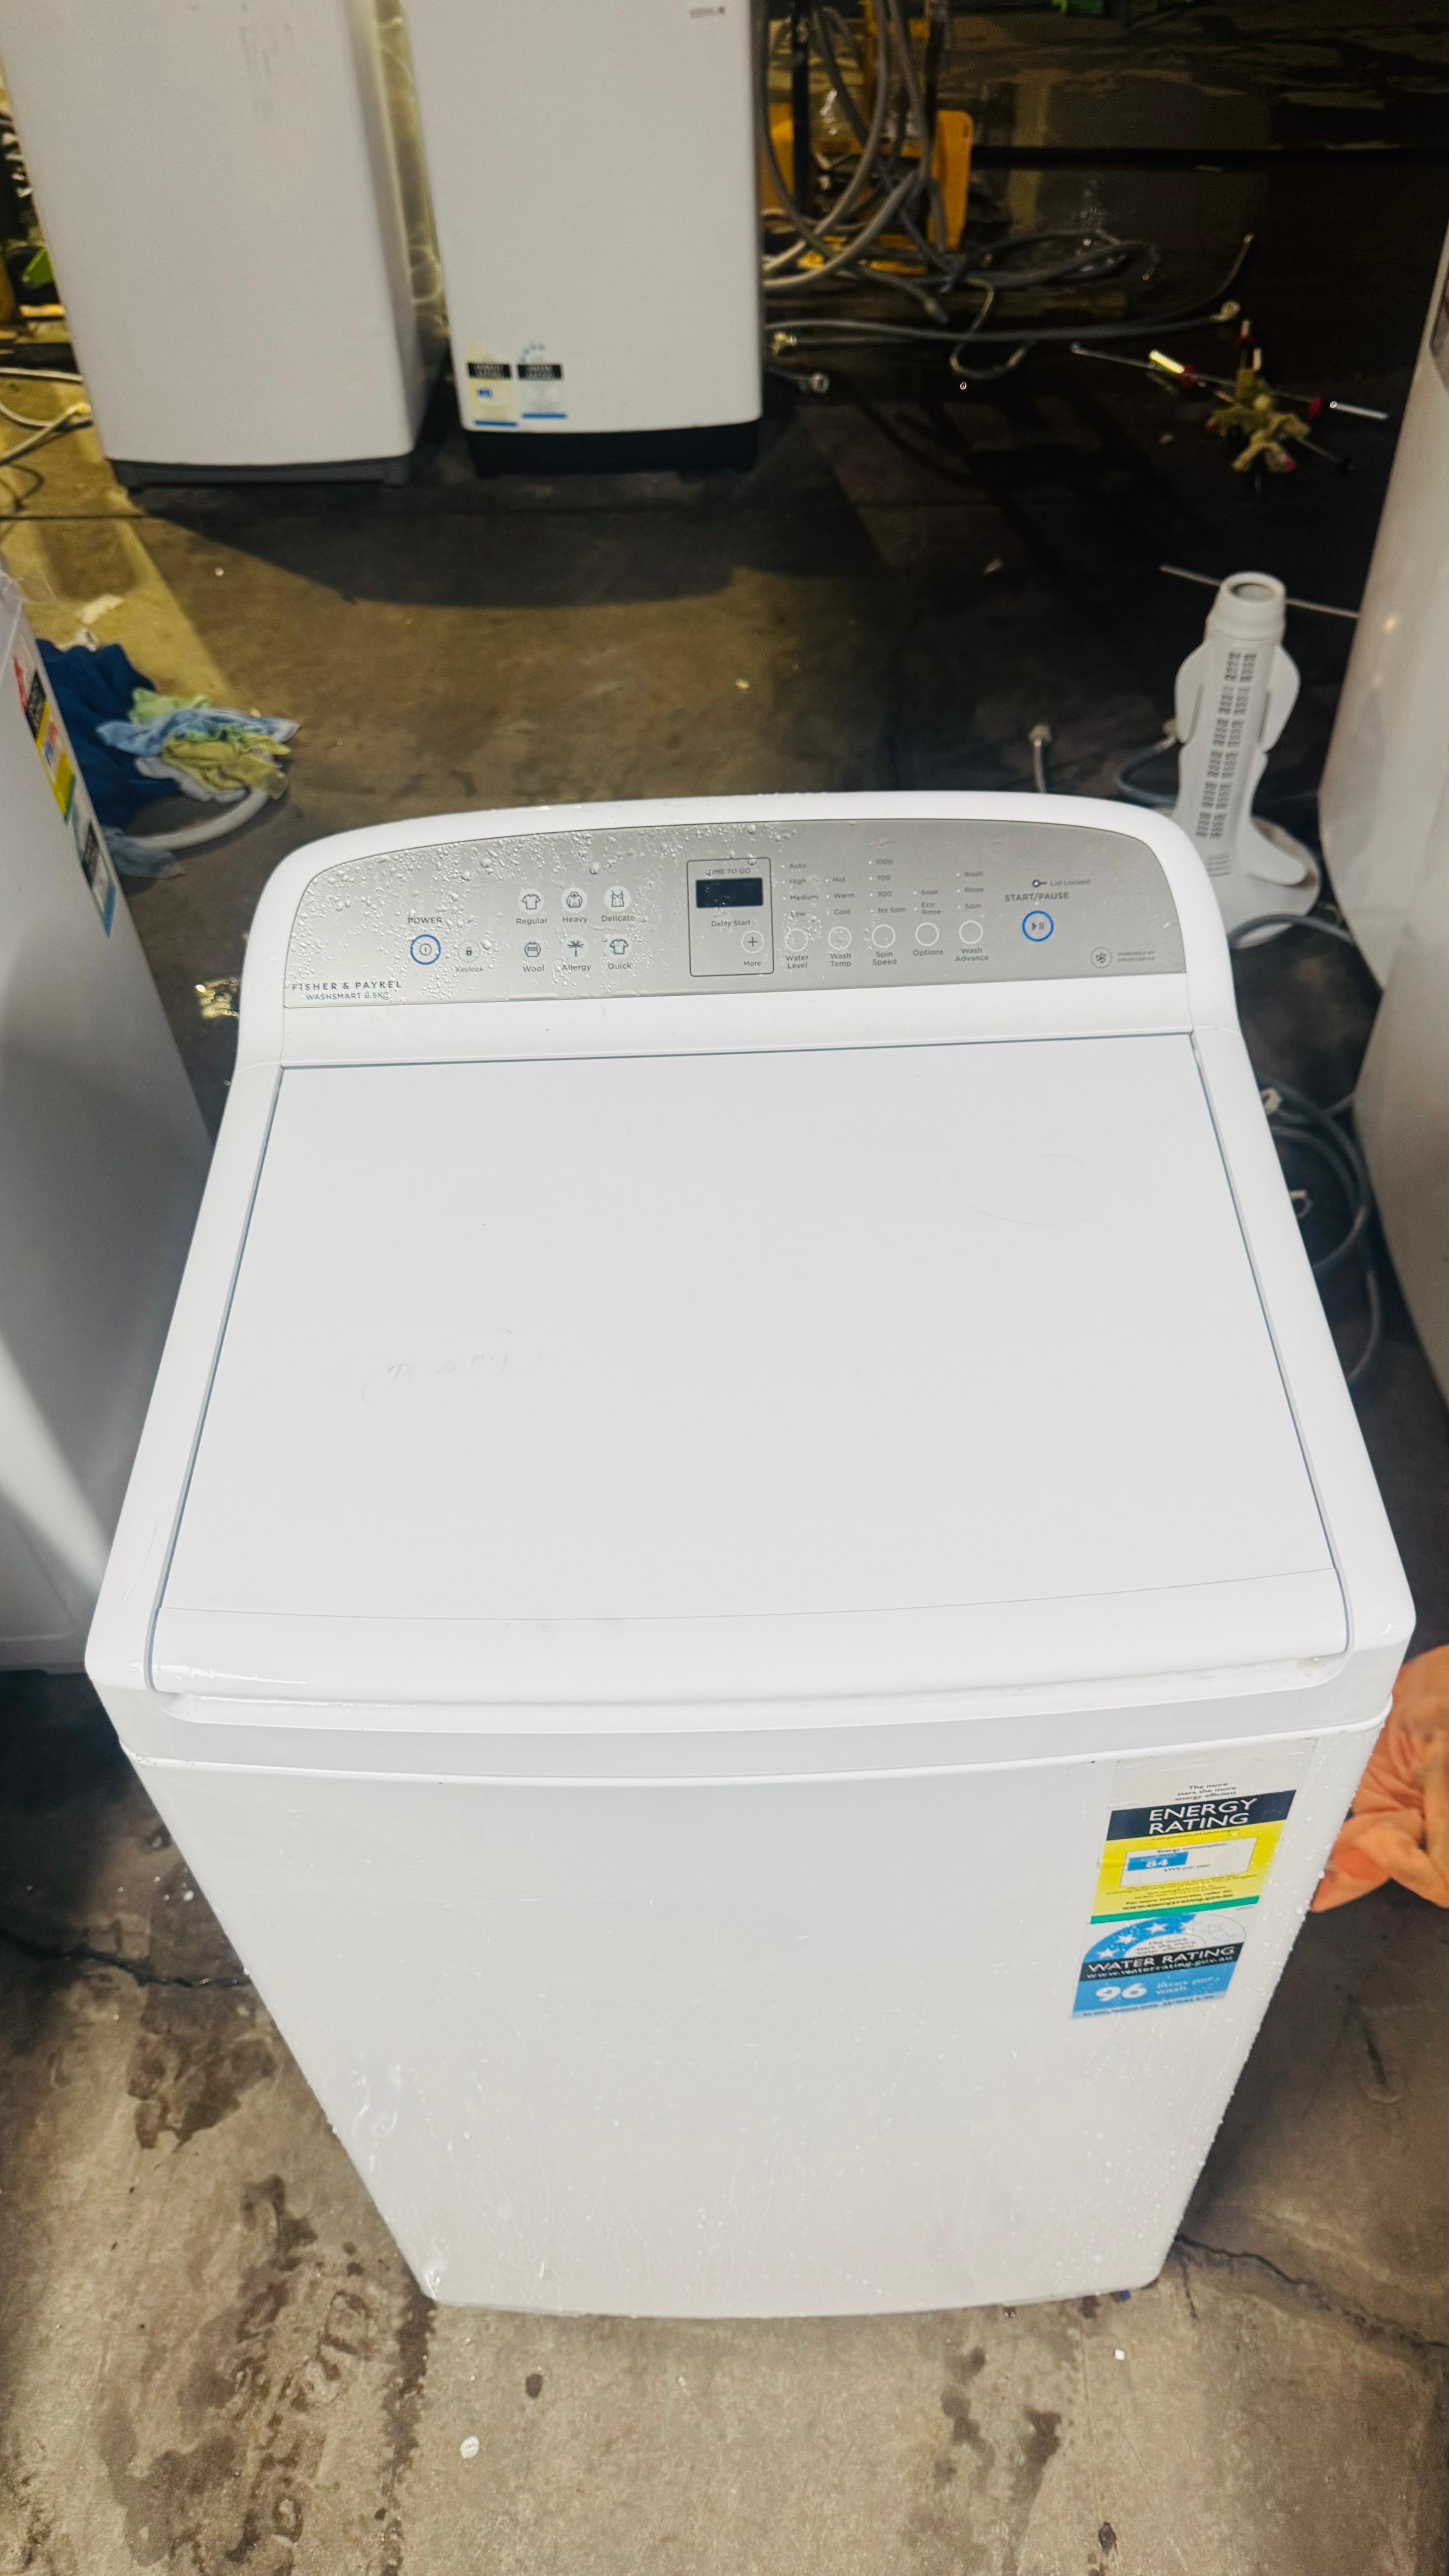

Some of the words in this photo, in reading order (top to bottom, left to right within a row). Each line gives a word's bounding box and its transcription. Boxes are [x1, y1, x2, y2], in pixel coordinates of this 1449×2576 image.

[1005, 893, 1069, 902] START/PAUSE
[292, 983, 337, 991] FISHER
[356, 981, 402, 990] PAYKEL
[1149, 1798, 1257, 1821] ENERGY
[1149, 1812, 1249, 1834] RATING
[1088, 1957, 1155, 1972] WATER
[1162, 1946, 1235, 1964] RATING
[1095, 1983, 1147, 2001] 96
